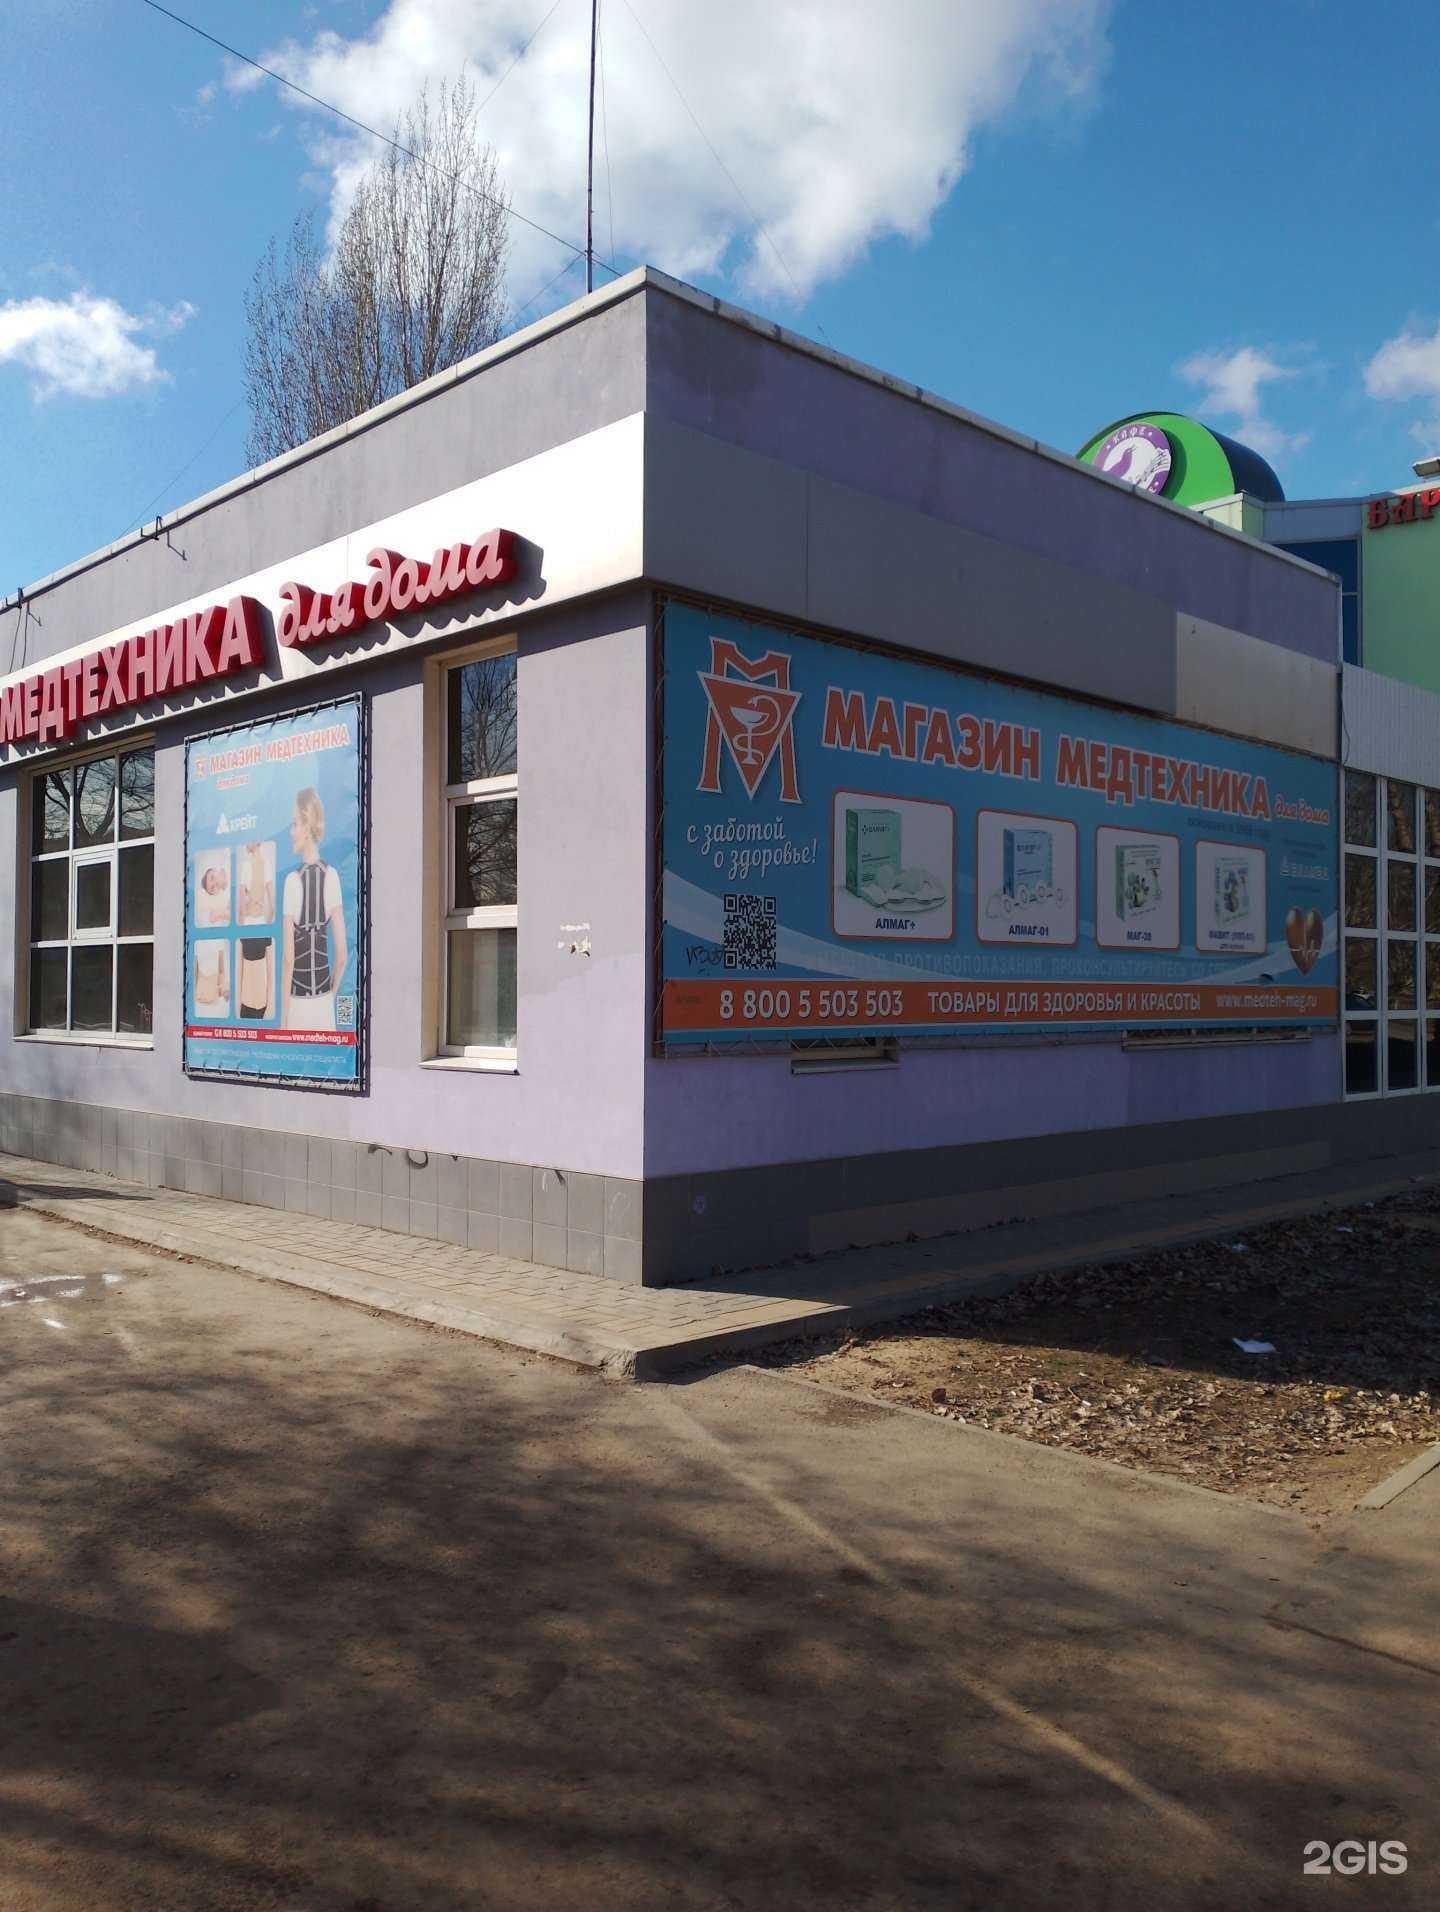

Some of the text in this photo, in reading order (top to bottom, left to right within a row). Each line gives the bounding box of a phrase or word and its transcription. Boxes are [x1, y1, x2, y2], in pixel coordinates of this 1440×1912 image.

[0, 528, 516, 743] МЕДТЕХНИКА для дома
[209, 723, 351, 775] МАГАЗИН МЕДТЕХНИКА
[822, 686, 1041, 782] МАГАЗИН
[1056, 735, 1272, 823] МЕДТЕХНИКА
[687, 816, 787, 855] с заботой
[714, 838, 817, 880] о здоровье!
[875, 917, 916, 931] АЛМАГ+
[1008, 925, 1050, 937] АЛМАГ-01
[719, 989, 904, 1020] 8 800 5 503 503
[927, 991, 1201, 1017] ТОВАРЫ ДЛЯ ЗДОРОВЬЯ И КРАСОТЫ
